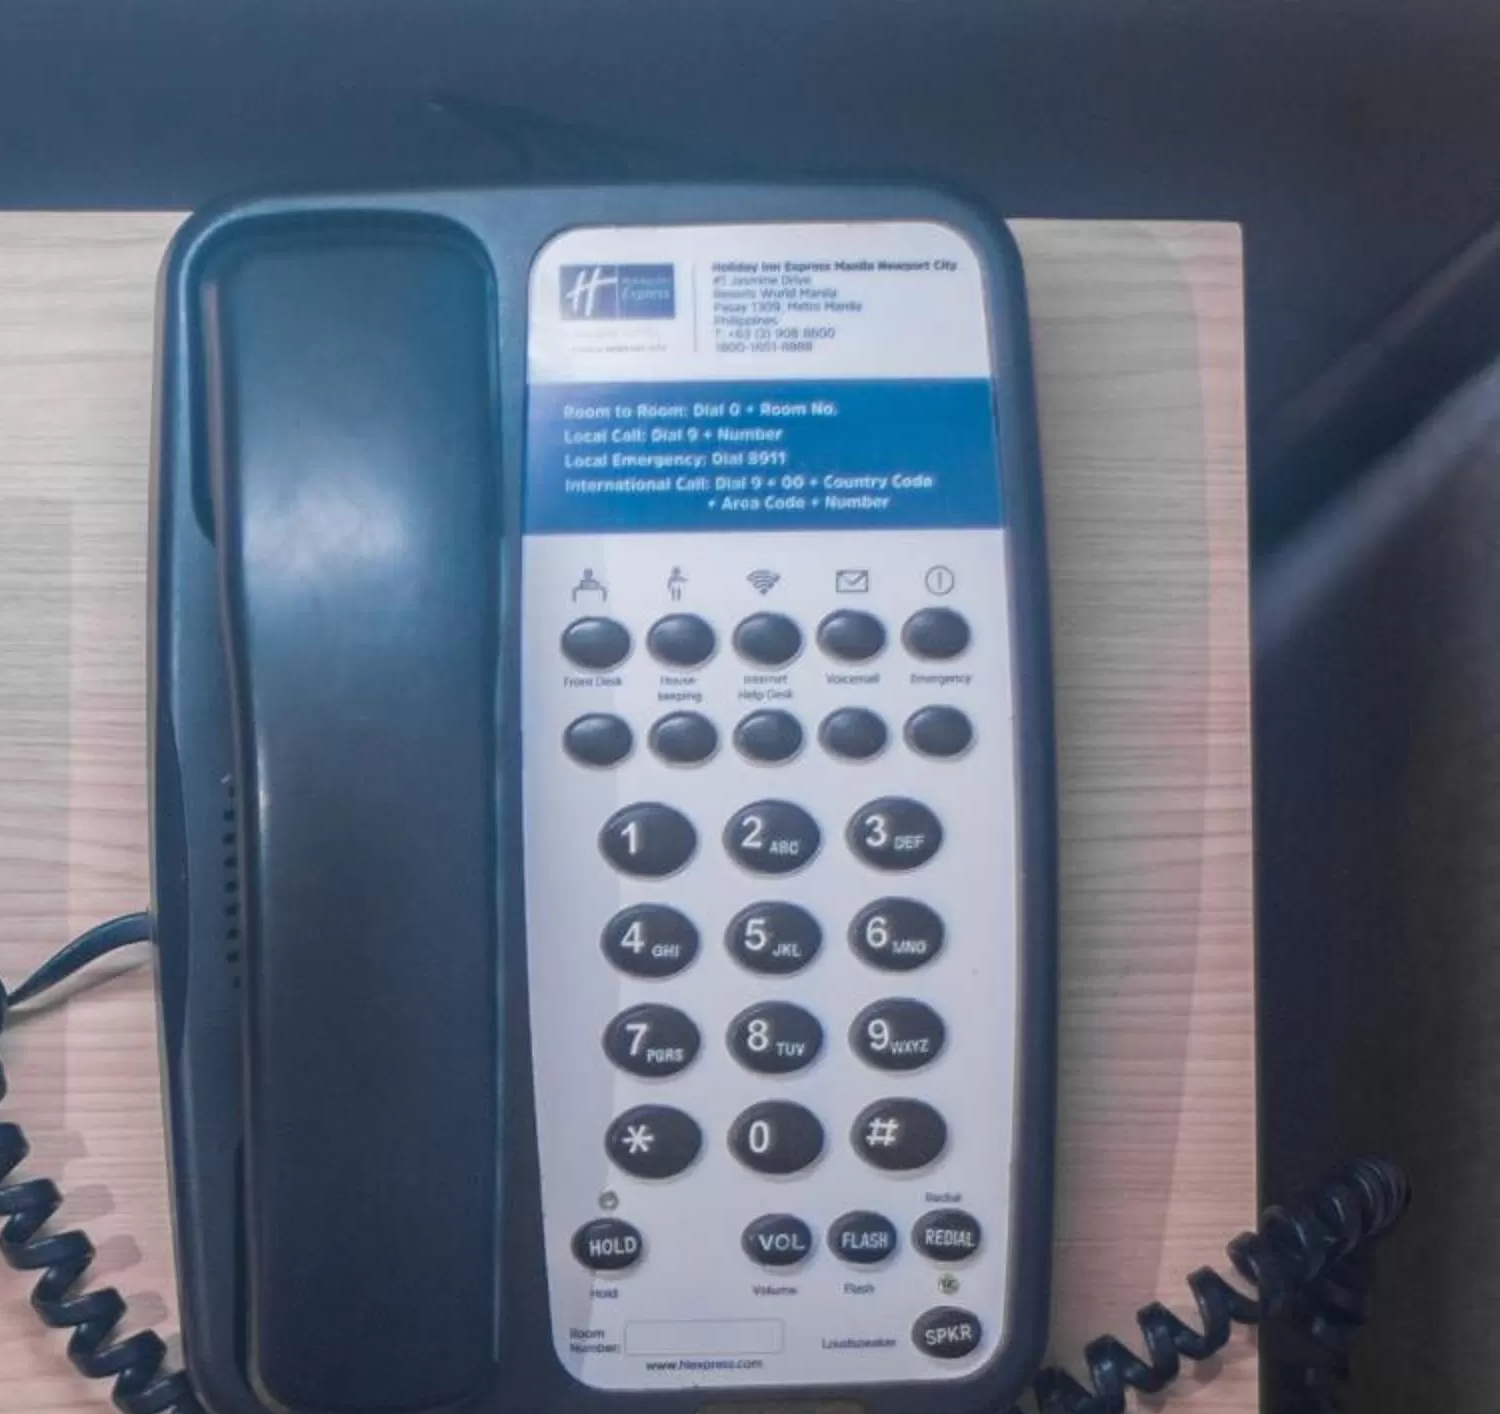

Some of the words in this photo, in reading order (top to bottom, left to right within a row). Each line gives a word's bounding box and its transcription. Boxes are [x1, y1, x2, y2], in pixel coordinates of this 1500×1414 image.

[563, 404, 610, 419] Room
[614, 405, 632, 418] to
[637, 403, 688, 418] Room:
[693, 402, 725, 417] Dial
[759, 402, 807, 416] Room
[812, 401, 839, 416] No.
[564, 429, 606, 444] Local
[612, 428, 647, 443] Call:
[651, 428, 683, 442] Dial
[687, 428, 699, 442] 9
[718, 427, 784, 442] Number
[565, 453, 607, 468] Local
[612, 452, 707, 470] Emergency:
[712, 451, 744, 466] Dial
[565, 476, 671, 493] International
[676, 476, 710, 491] Call:
[715, 475, 747, 491] Dial
[751, 475, 762, 490] 9
[824, 474, 887, 492] Country
[892, 473, 933, 488] Code
[722, 496, 760, 511] Area
[764, 496, 805, 511] Code
[825, 495, 889, 510] Number
[825, 673, 880, 686] Voicemail
[909, 672, 973, 687] Emergency
[620, 822, 639, 855] 1
[741, 816, 763, 849] 2
[769, 840, 800, 857] ABC
[866, 814, 887, 847] 3
[894, 834, 925, 851] DEF
[620, 921, 645, 955] 4
[652, 945, 680, 958] GHI
[744, 918, 768, 951] 5
[772, 943, 801, 957] JKL
[866, 916, 888, 949] 6
[892, 940, 927, 955] MNO
[625, 1023, 649, 1056] 7
[747, 1019, 769, 1052] 8
[776, 1042, 805, 1057] TUV
[868, 1019, 889, 1051] 9
[890, 1039, 929, 1055] WXYZ
[749, 1120, 770, 1153] 0
[588, 1237, 637, 1257] HOLD
[757, 1233, 805, 1252] VOL
[841, 1232, 888, 1250] FLASH
[924, 1228, 976, 1248] REDIAL
[589, 1287, 618, 1299] Hold
[752, 1284, 798, 1296] Volume
[843, 1283, 875, 1295] Flash
[924, 1325, 973, 1345] SPKR
